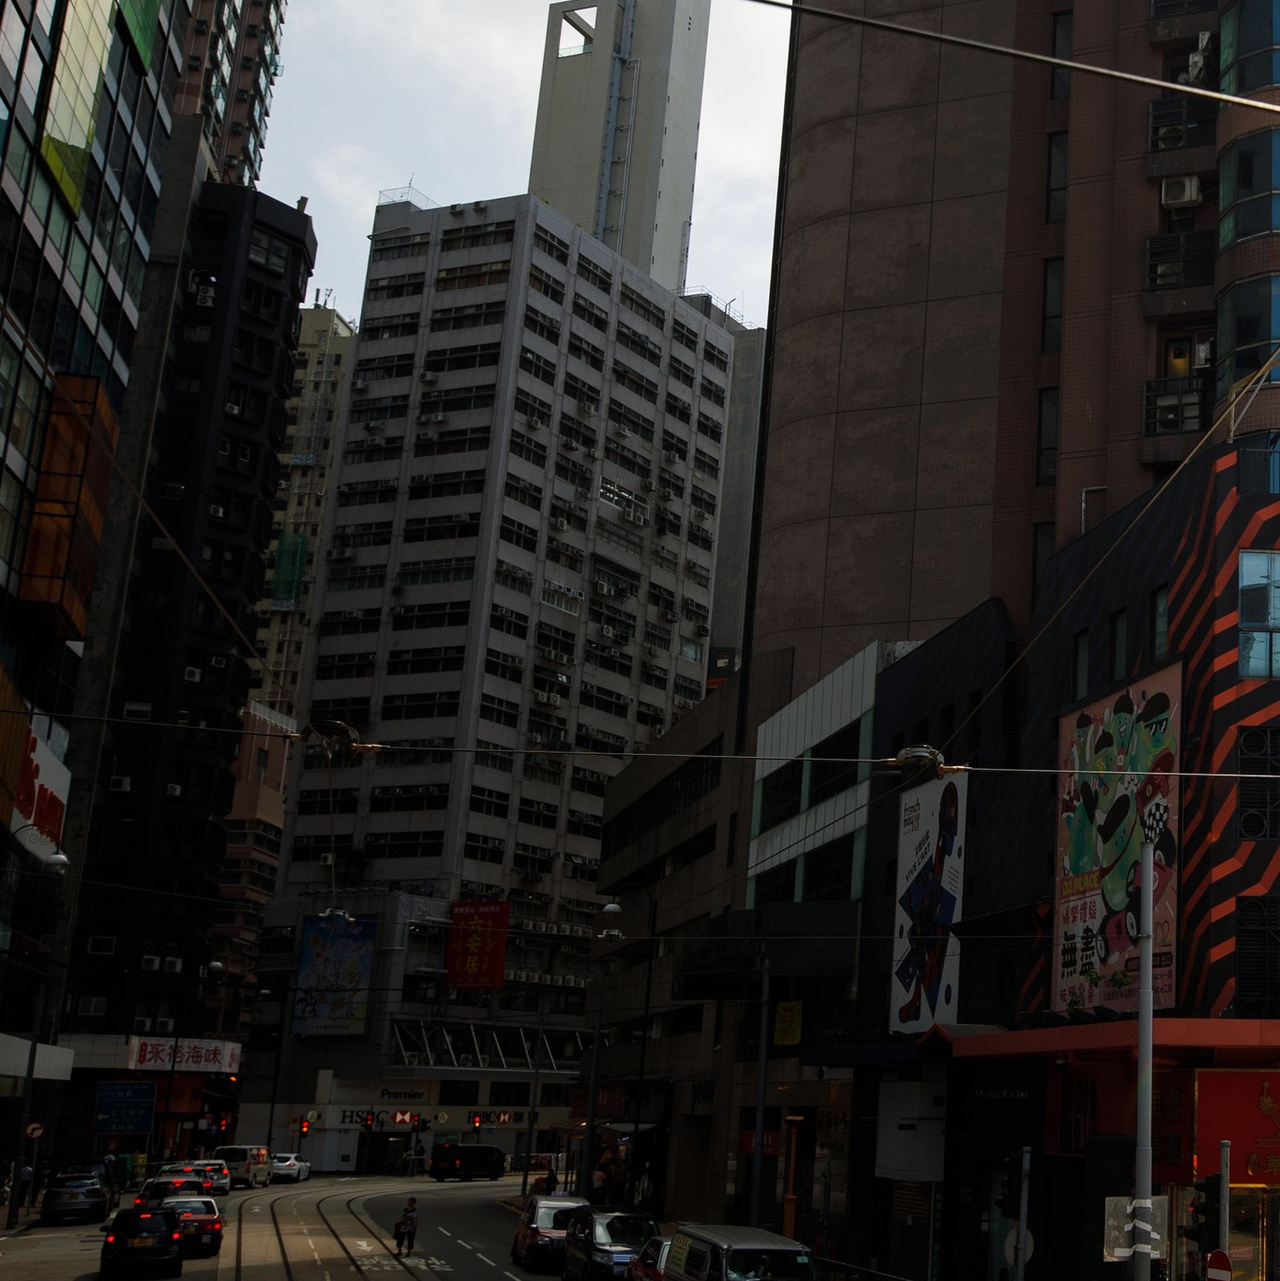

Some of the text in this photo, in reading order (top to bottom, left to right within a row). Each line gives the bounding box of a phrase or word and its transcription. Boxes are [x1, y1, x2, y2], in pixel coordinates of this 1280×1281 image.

[1074, 871, 1099, 892] PLACE
[381, 1089, 424, 1100] Premier
[467, 1111, 496, 1124] HBC
